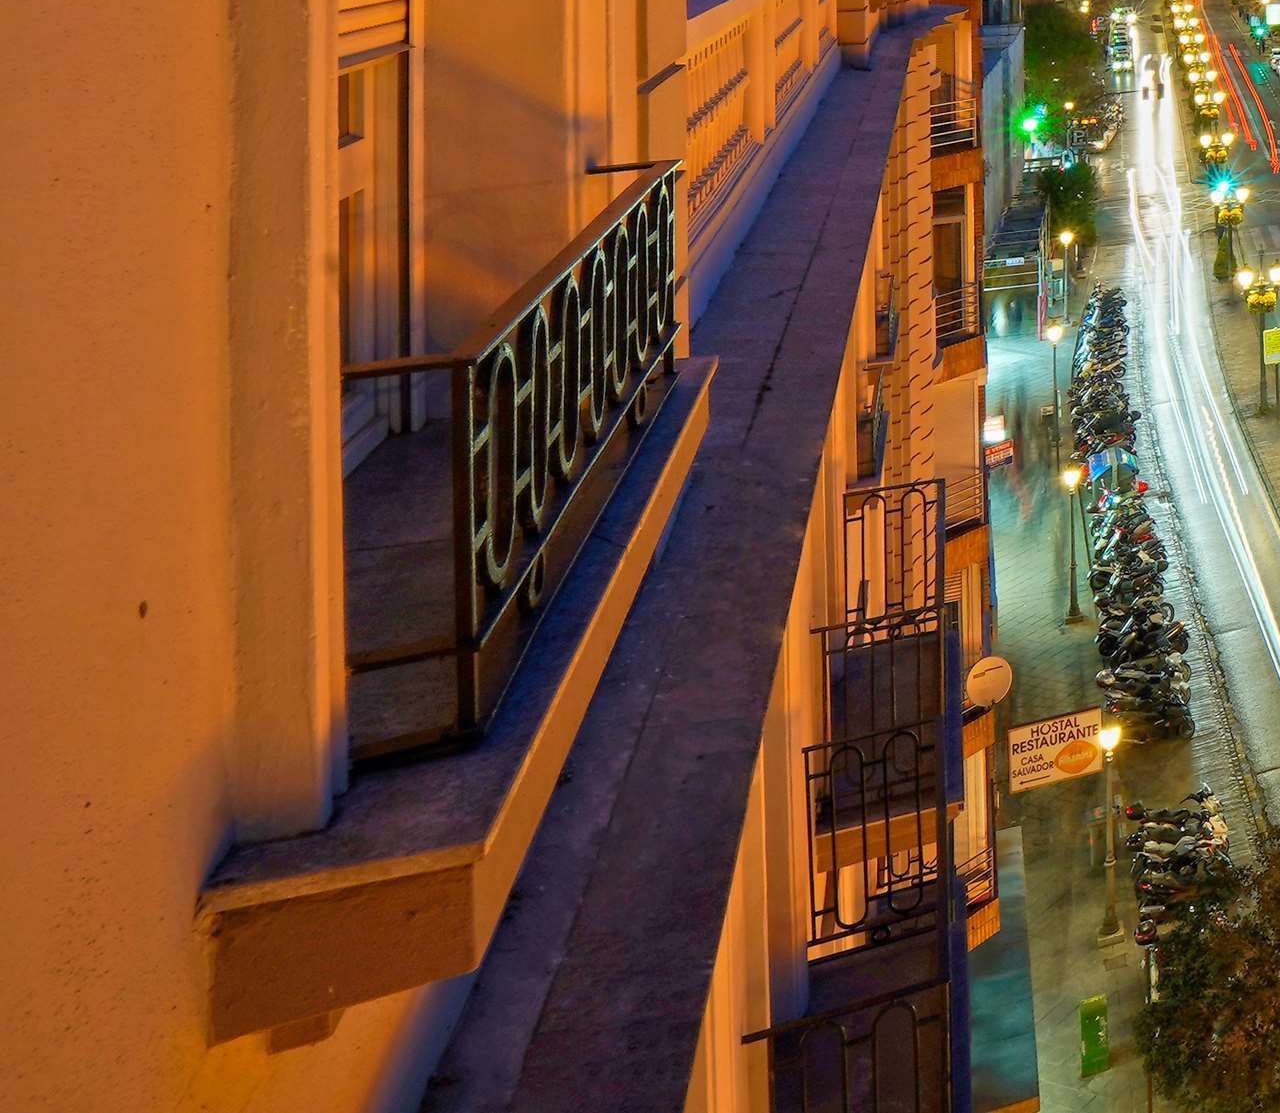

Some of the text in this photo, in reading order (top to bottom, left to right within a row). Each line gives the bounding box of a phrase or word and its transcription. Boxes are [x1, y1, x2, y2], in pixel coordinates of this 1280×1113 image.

[1030, 717, 1080, 739] HOSTAL
[1012, 724, 1099, 756] RESTAURANTE
[1012, 760, 1055, 779] SALVADOR
[1020, 753, 1044, 766] CASA
